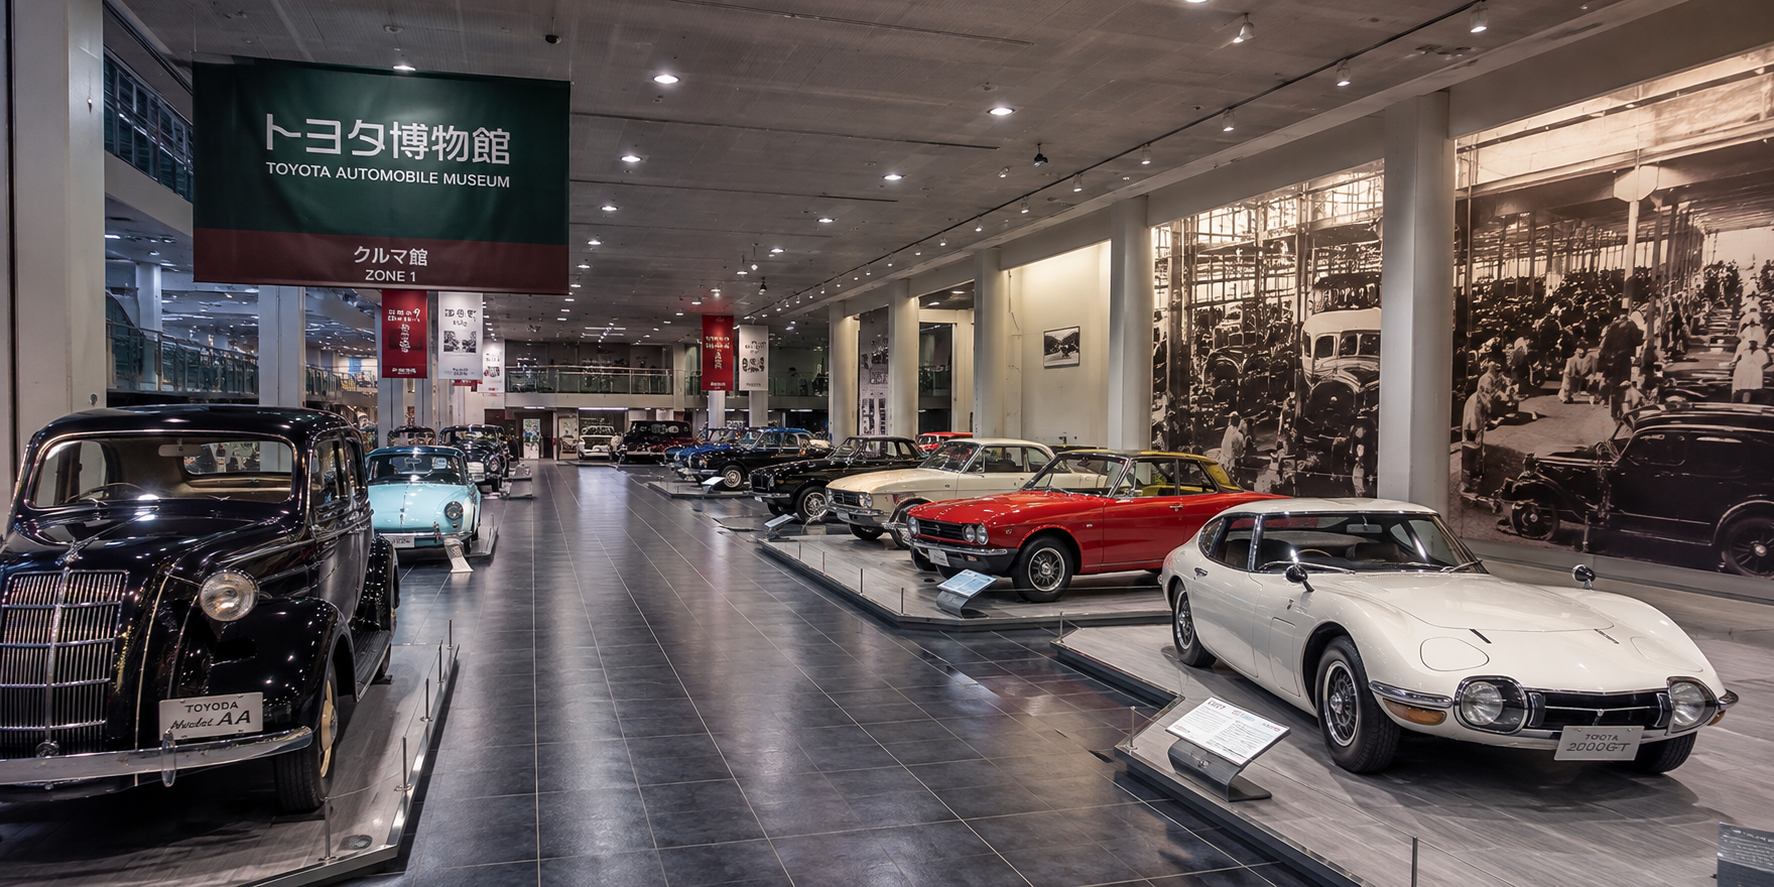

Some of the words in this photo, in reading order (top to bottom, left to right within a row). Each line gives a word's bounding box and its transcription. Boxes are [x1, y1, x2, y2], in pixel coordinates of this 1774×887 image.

[266, 112, 510, 165] トヨタ博物館
[266, 161, 331, 178] TOYOTA
[335, 166, 438, 184] AUTOMOBILE
[443, 172, 510, 188] MUSEUM
[353, 245, 428, 267] クルマ館
[365, 269, 406, 282] ZONE
[410, 271, 416, 282] 1
[184, 701, 239, 713] TOYODA
[1566, 742, 1631, 752] 2000GT
